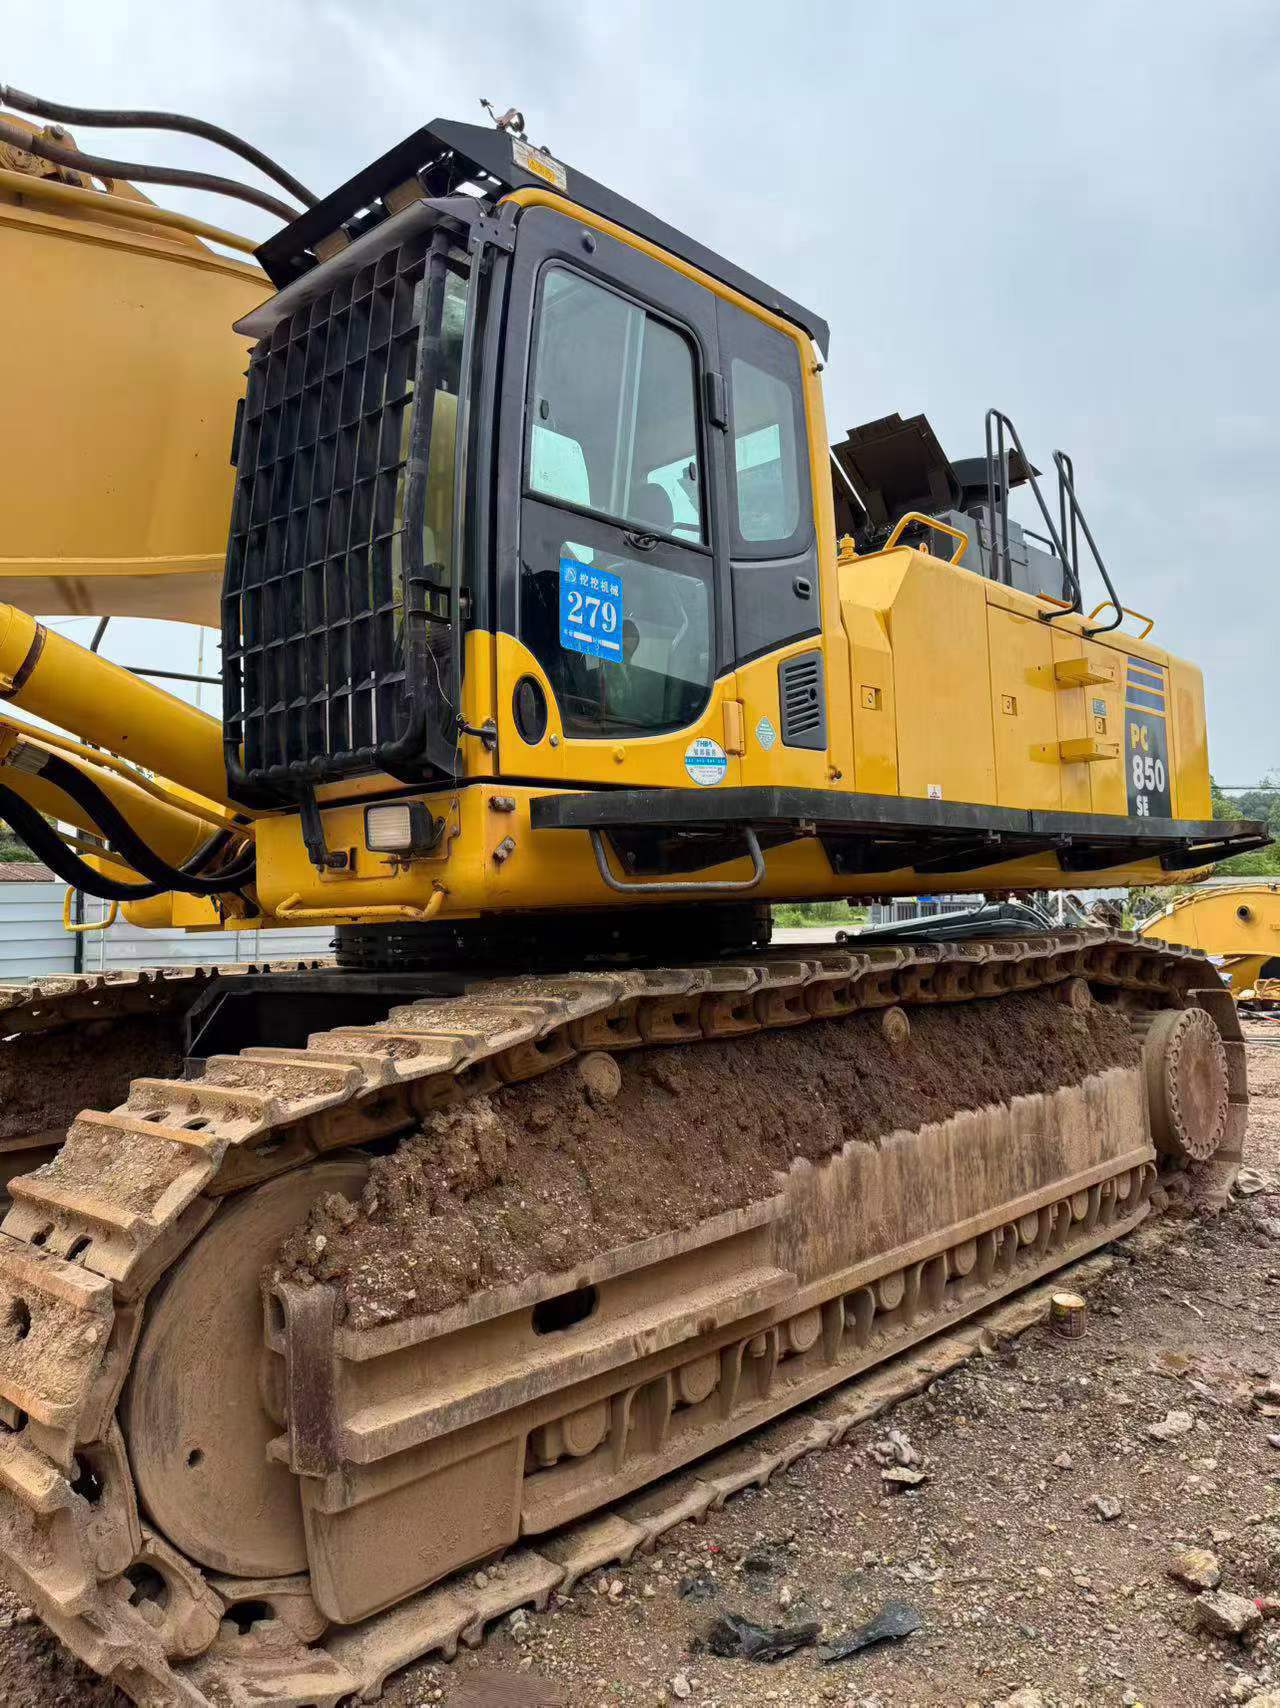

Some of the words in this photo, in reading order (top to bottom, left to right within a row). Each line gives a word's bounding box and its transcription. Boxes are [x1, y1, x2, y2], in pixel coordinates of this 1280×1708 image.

[568, 591, 617, 633] 279
[1130, 722, 1149, 752] PC
[1132, 754, 1165, 793] 850
[1136, 795, 1150, 816] SE
